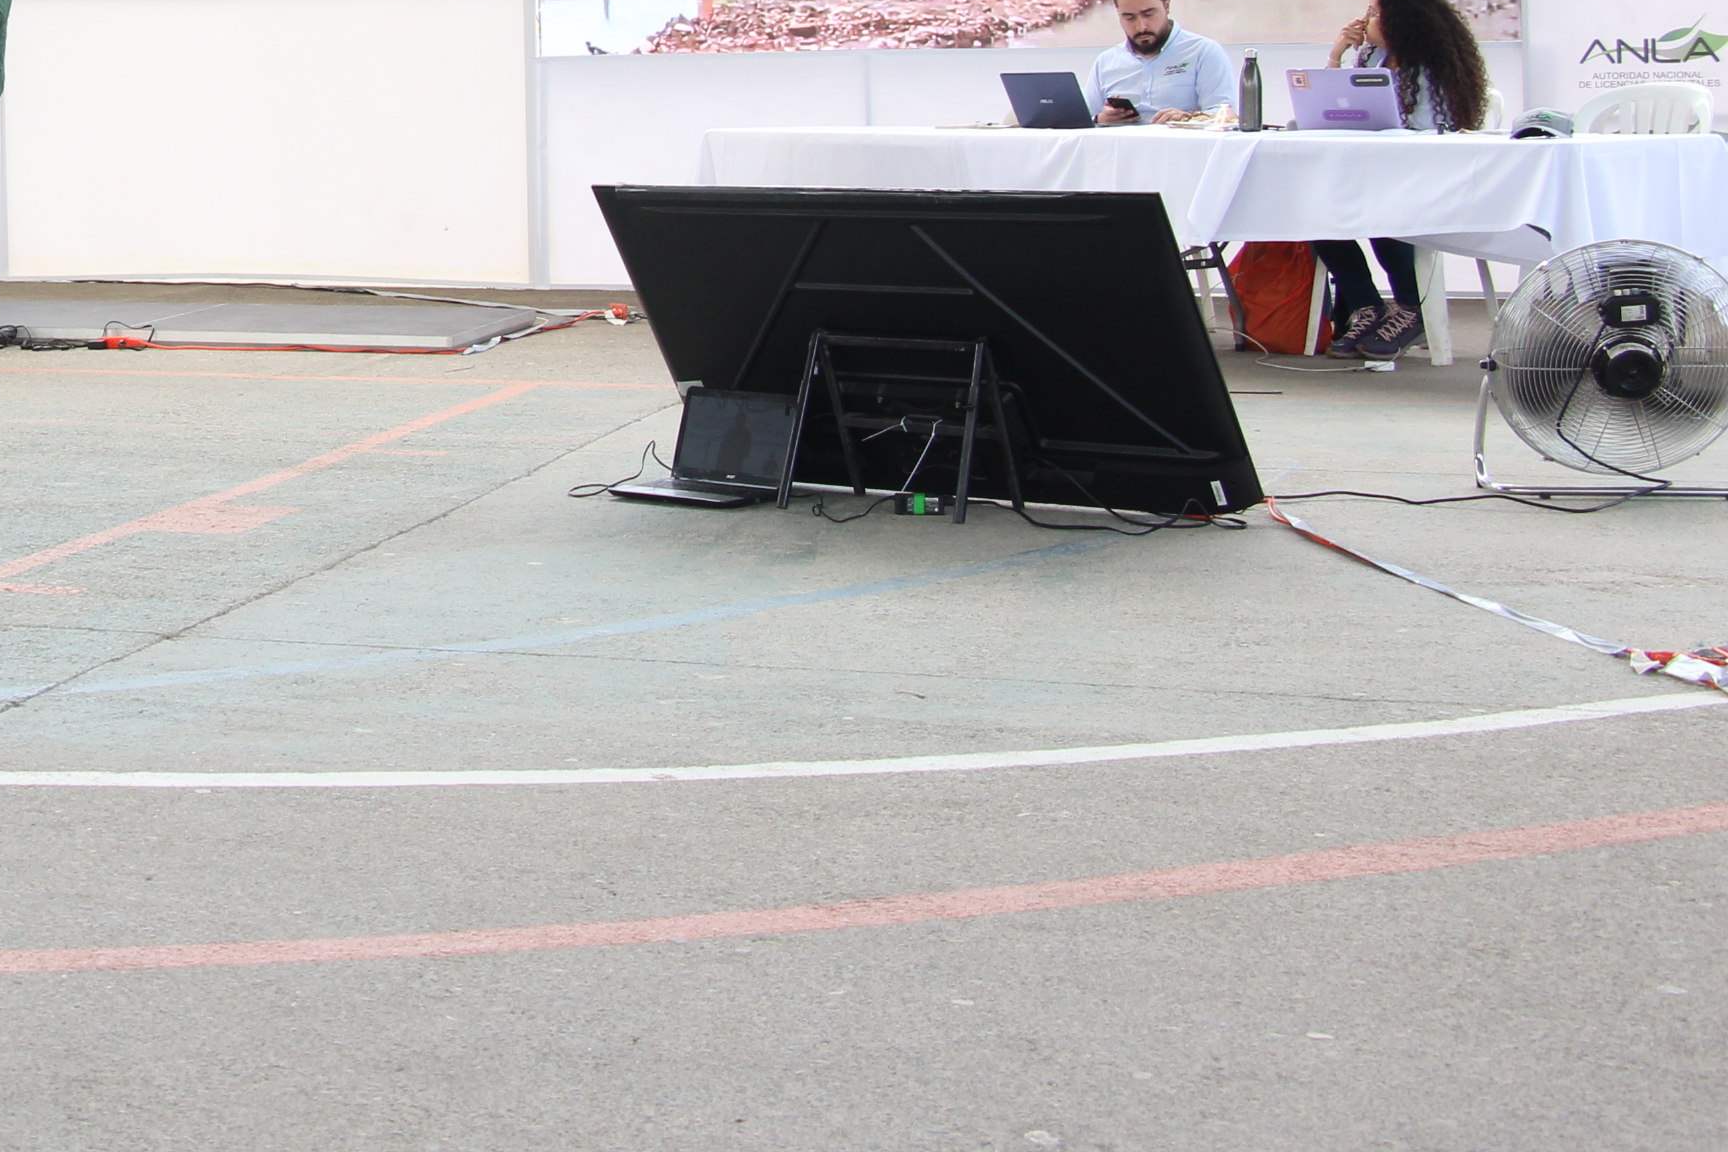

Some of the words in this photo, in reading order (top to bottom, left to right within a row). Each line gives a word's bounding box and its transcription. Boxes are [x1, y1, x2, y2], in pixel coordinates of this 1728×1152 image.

[1579, 36, 1720, 64] ANLA
[1591, 71, 1650, 80] AUTORIDAD
[1652, 70, 1704, 79] NACIONAL
[1578, 80, 1592, 89] DE
